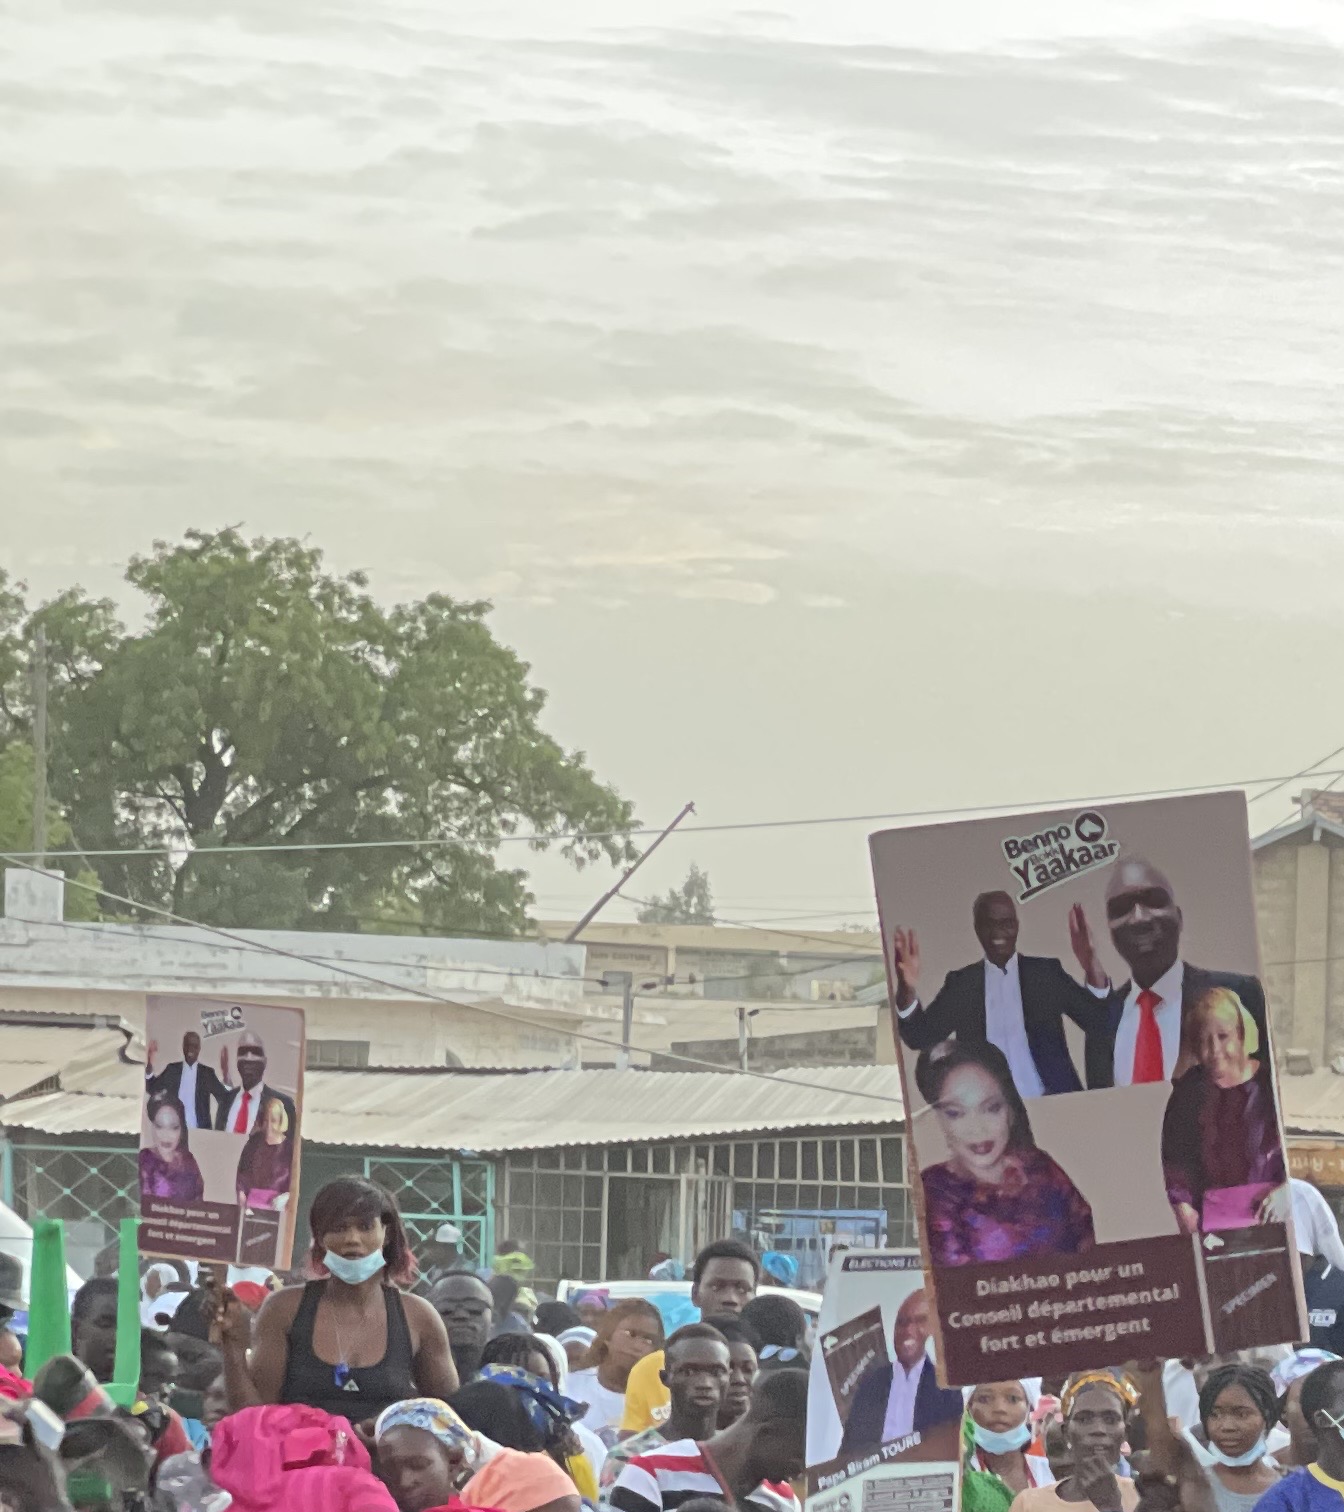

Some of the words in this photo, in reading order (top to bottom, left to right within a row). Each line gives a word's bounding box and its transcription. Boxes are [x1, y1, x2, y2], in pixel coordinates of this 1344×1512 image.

[1004, 825, 1071, 859] Benno
[1013, 842, 1118, 889] Yaakaar
[1066, 1266, 1111, 1289] pour
[1117, 1262, 1145, 1279] un
[1027, 1283, 1180, 1320] départemental
[980, 1334, 1021, 1353] fort
[1025, 1331, 1047, 1347] et
